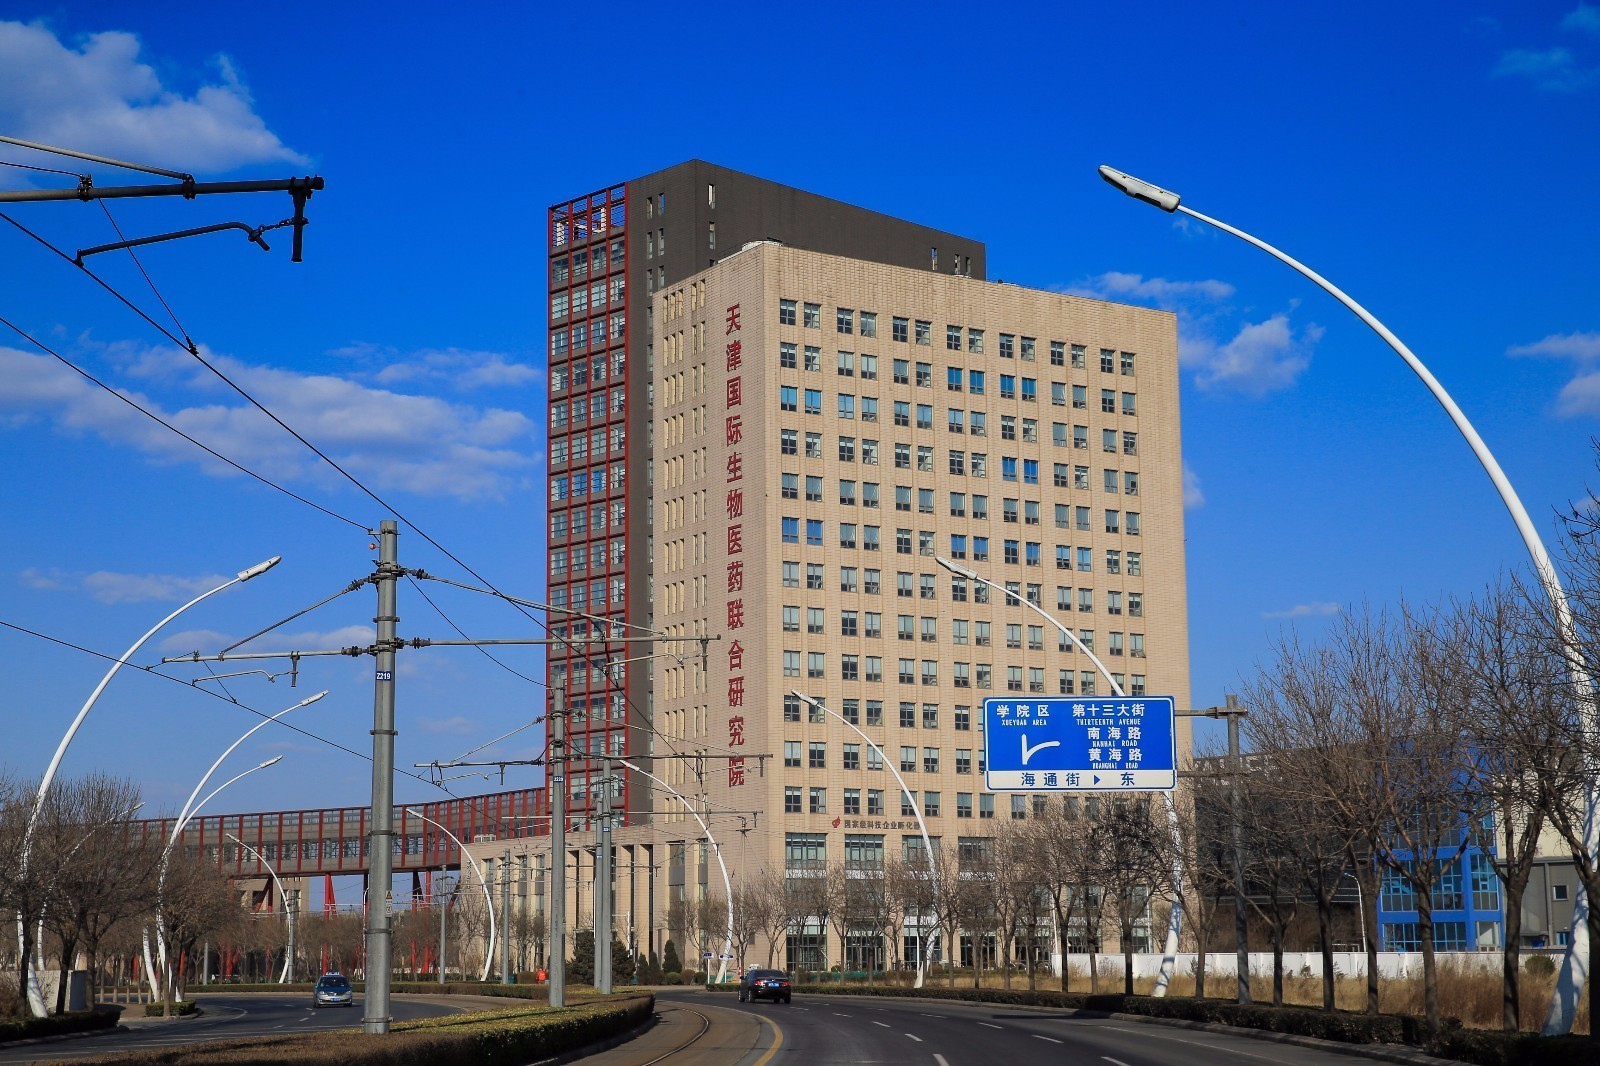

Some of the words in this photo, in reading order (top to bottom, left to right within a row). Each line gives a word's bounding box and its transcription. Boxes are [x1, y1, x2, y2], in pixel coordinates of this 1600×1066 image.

[725, 302, 745, 788] 天津国际生物医药联合研究院
[996, 704, 1050, 718] 学院区
[1072, 703, 1145, 718] 第十三大街
[1076, 718, 1114, 726] THIRTEENTH
[1118, 718, 1141, 726] AVENUE
[1087, 727, 1142, 740] 南海路
[1092, 740, 1116, 748] NANHAI
[1121, 739, 1138, 747] ROAD
[1088, 748, 1143, 762] 黄海路
[1092, 762, 1118, 770] HUANGHAI
[1021, 772, 1080, 787] 海通街
[1120, 772, 1135, 786] 东
